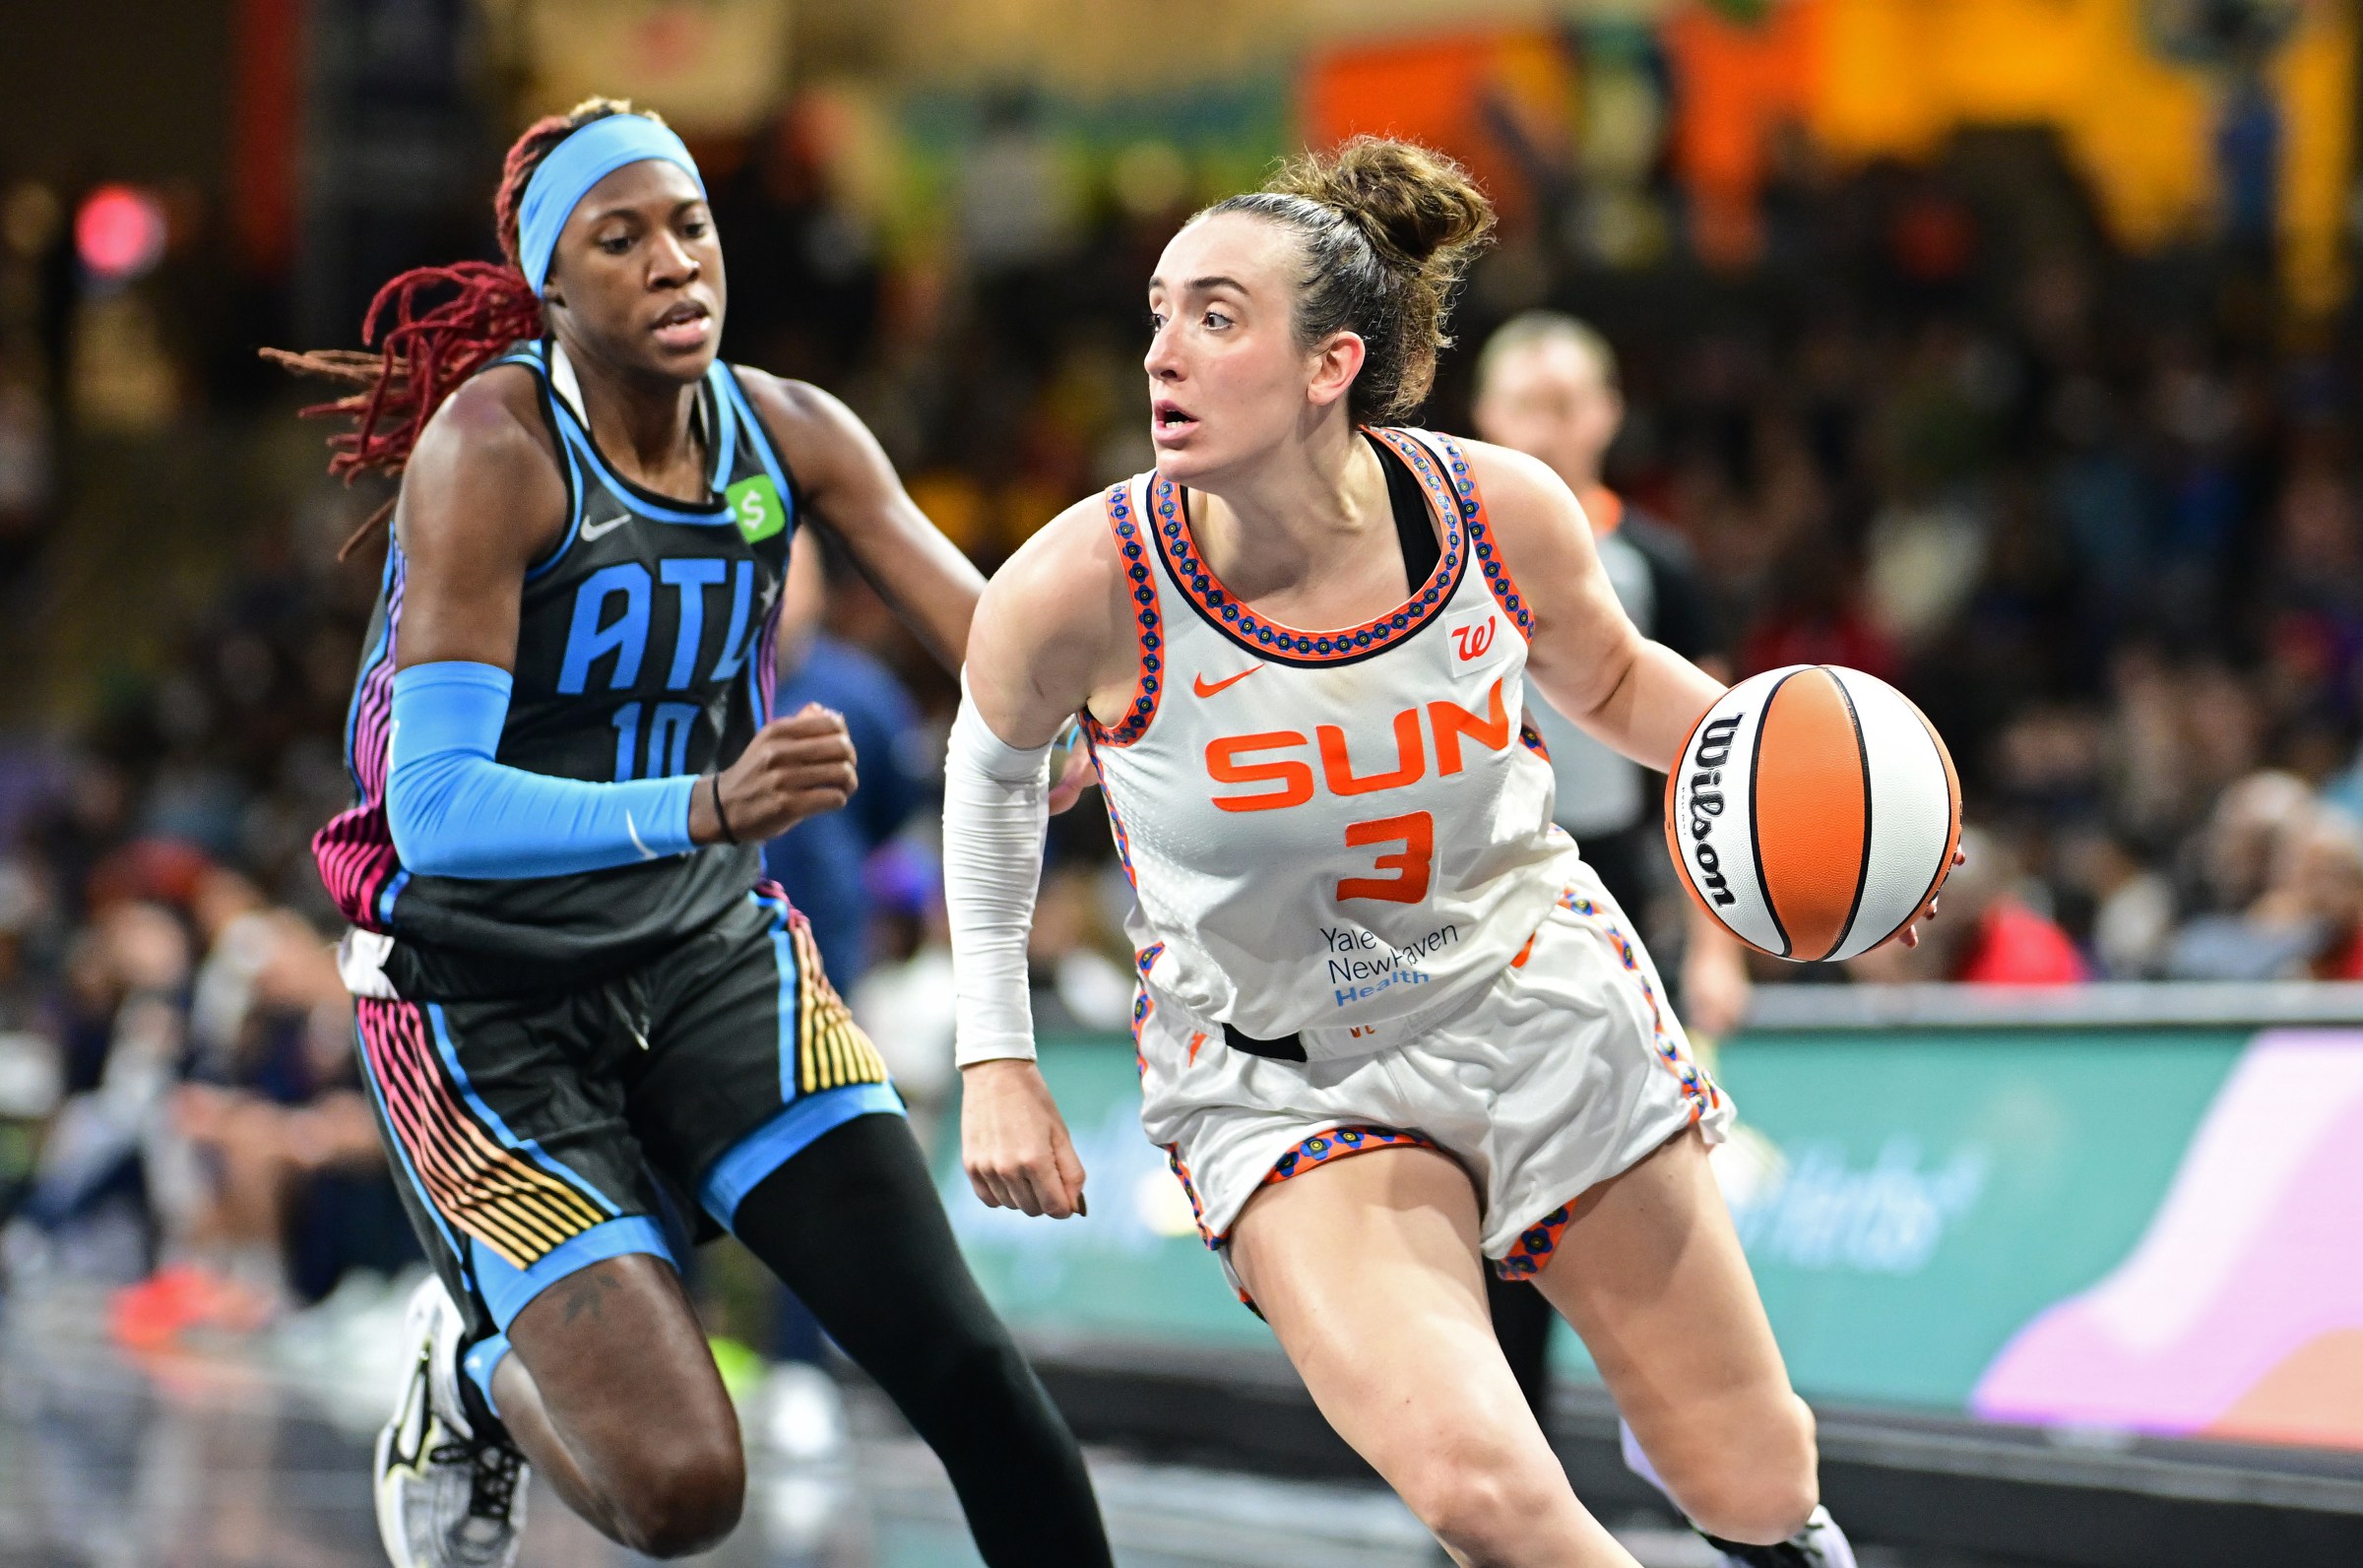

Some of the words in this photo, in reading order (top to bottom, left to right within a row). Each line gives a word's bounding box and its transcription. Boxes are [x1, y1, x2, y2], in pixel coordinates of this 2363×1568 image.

[556, 557, 759, 695] ATL
[610, 701, 702, 784] 10
[1204, 676, 1509, 813] SUN
[1336, 810, 1435, 905] 3
[1689, 711, 1747, 909] Wilson
[1319, 927, 1377, 954] Yale
[1334, 970, 1430, 1008] Health
